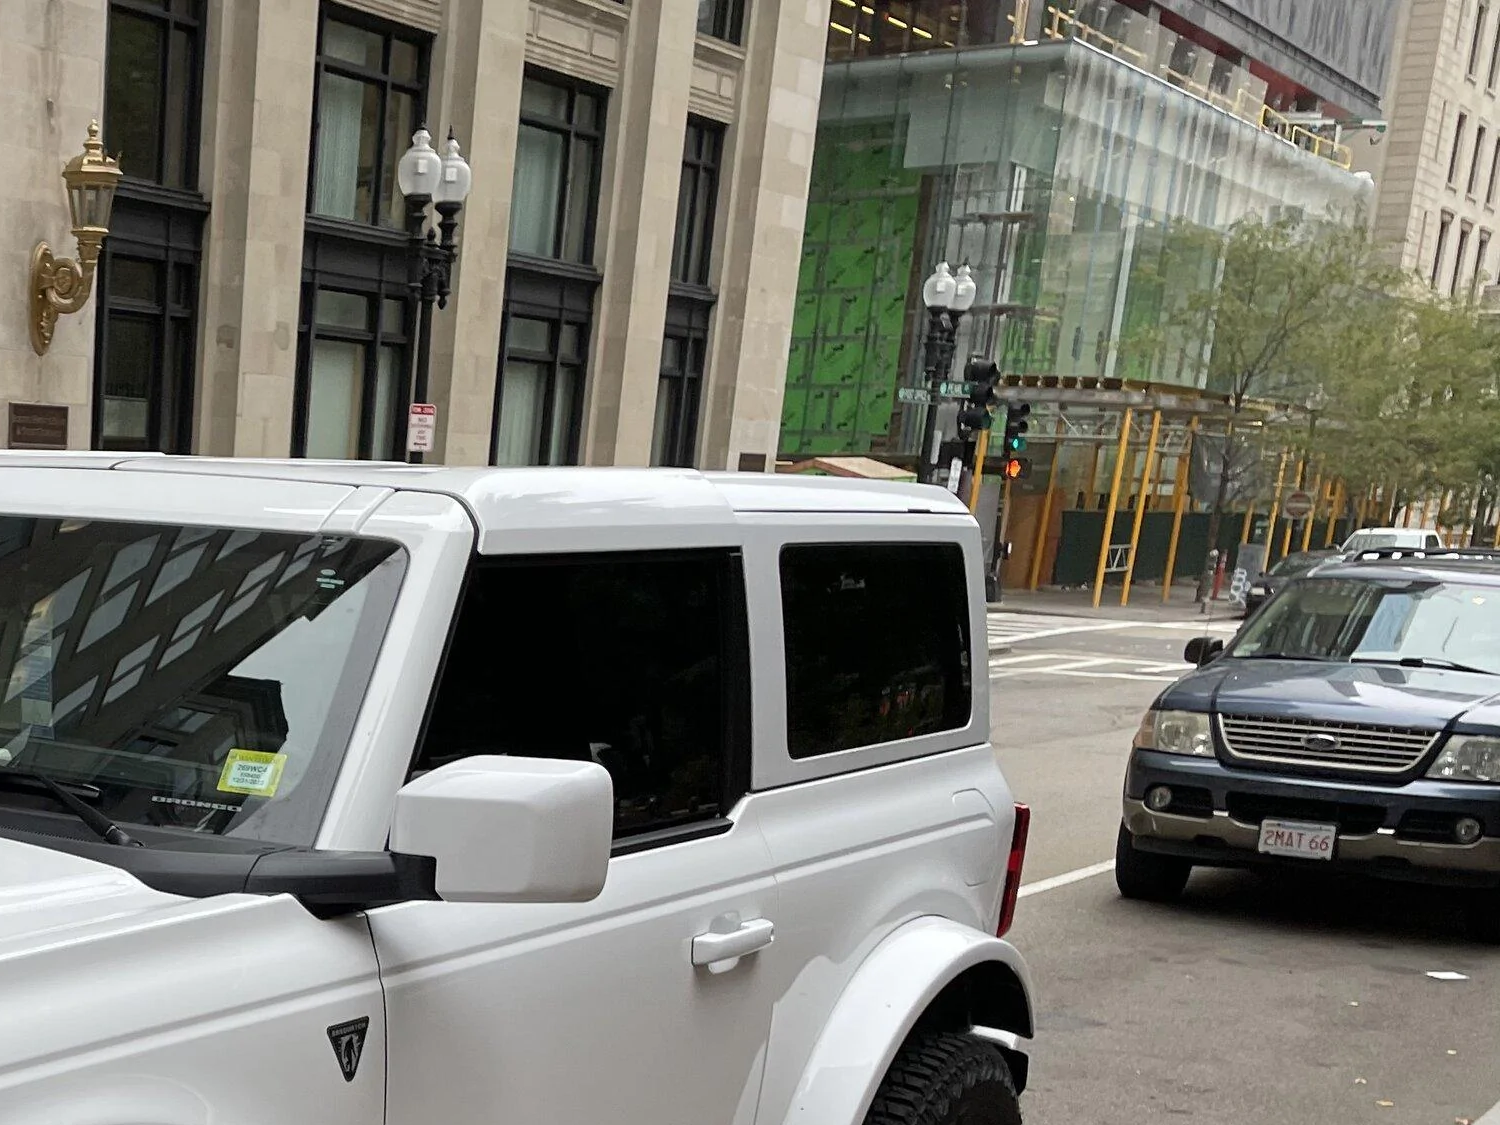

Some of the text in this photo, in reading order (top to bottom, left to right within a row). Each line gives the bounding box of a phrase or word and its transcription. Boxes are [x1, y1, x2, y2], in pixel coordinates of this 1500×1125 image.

[151, 796, 242, 812] BRONCO
[1263, 829, 1331, 851] 2MAT 66
